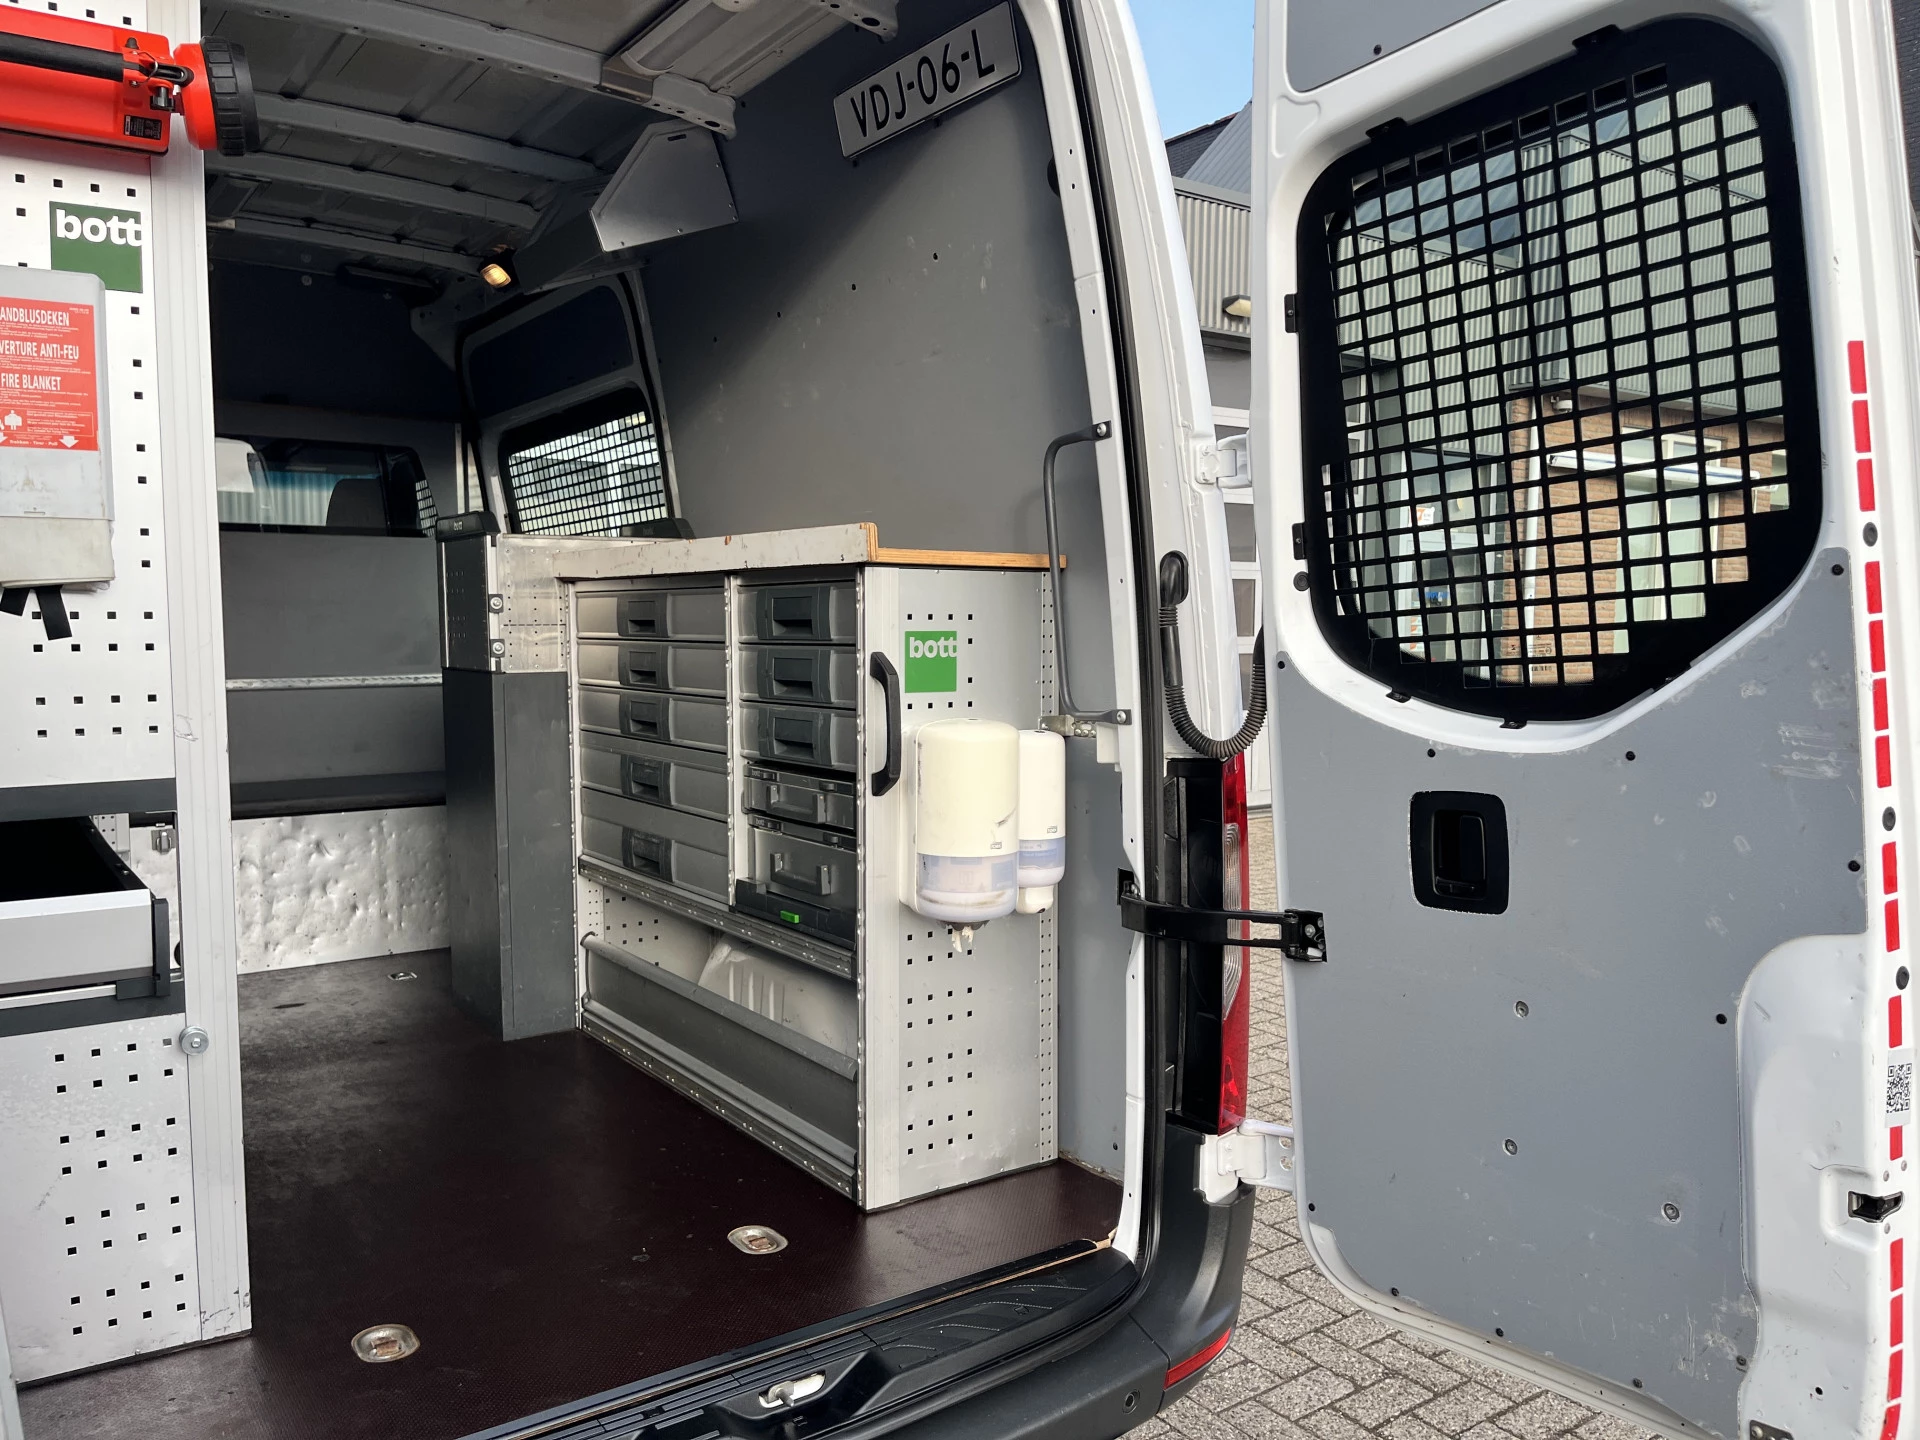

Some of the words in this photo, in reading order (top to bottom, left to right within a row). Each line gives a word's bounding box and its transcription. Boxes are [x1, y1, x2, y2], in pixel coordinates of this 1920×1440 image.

[850, 29, 995, 138] VDJ-06-L
[56, 208, 142, 247] bott
[40, 343, 79, 360] ANTI-FEU
[1, 373, 20, 388] FIRE
[22, 374, 61, 390] BLANKET
[909, 636, 957, 658] bott
